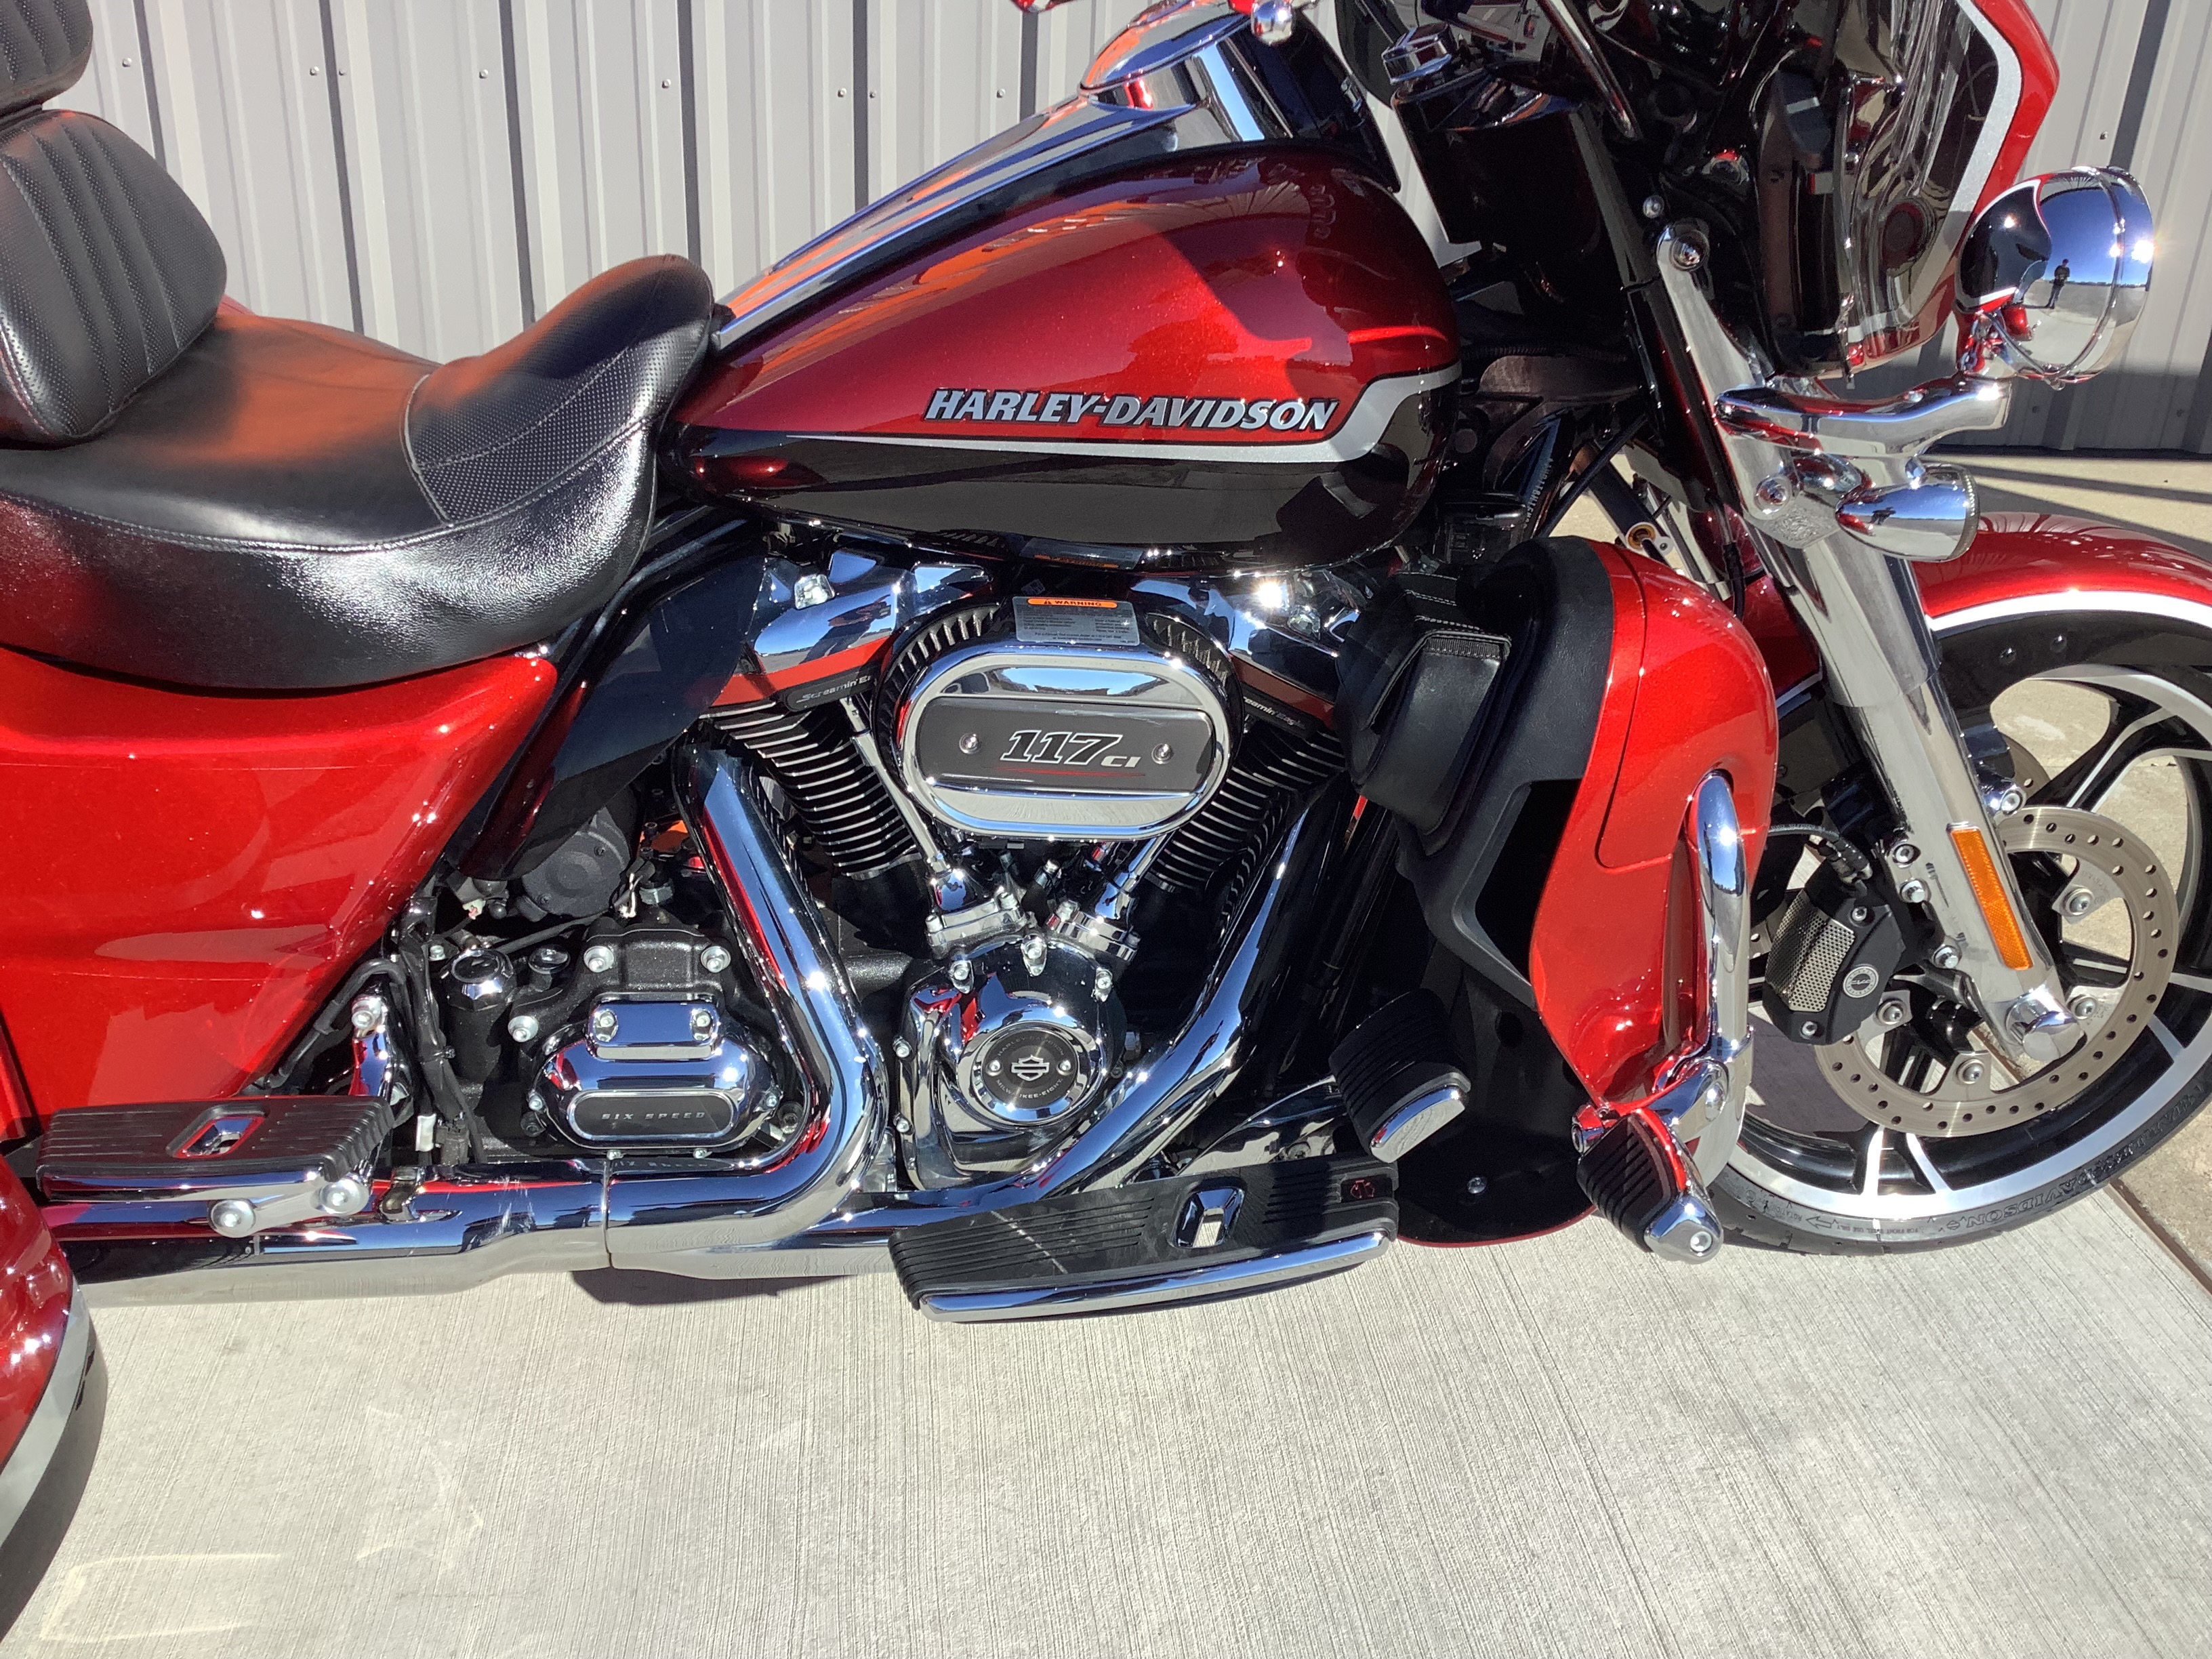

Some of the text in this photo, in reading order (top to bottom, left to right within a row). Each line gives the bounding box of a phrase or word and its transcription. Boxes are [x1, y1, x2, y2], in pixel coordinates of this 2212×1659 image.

[923, 388, 1340, 432] HARLEY-DAVIDSON
[1000, 729, 1141, 768] 117 CI
[997, 1036, 1065, 1056] HARLEY-DADSON
[996, 1079, 1063, 1099] MILWKEE-EIGHT
[644, 1112, 705, 1120] SPEED
